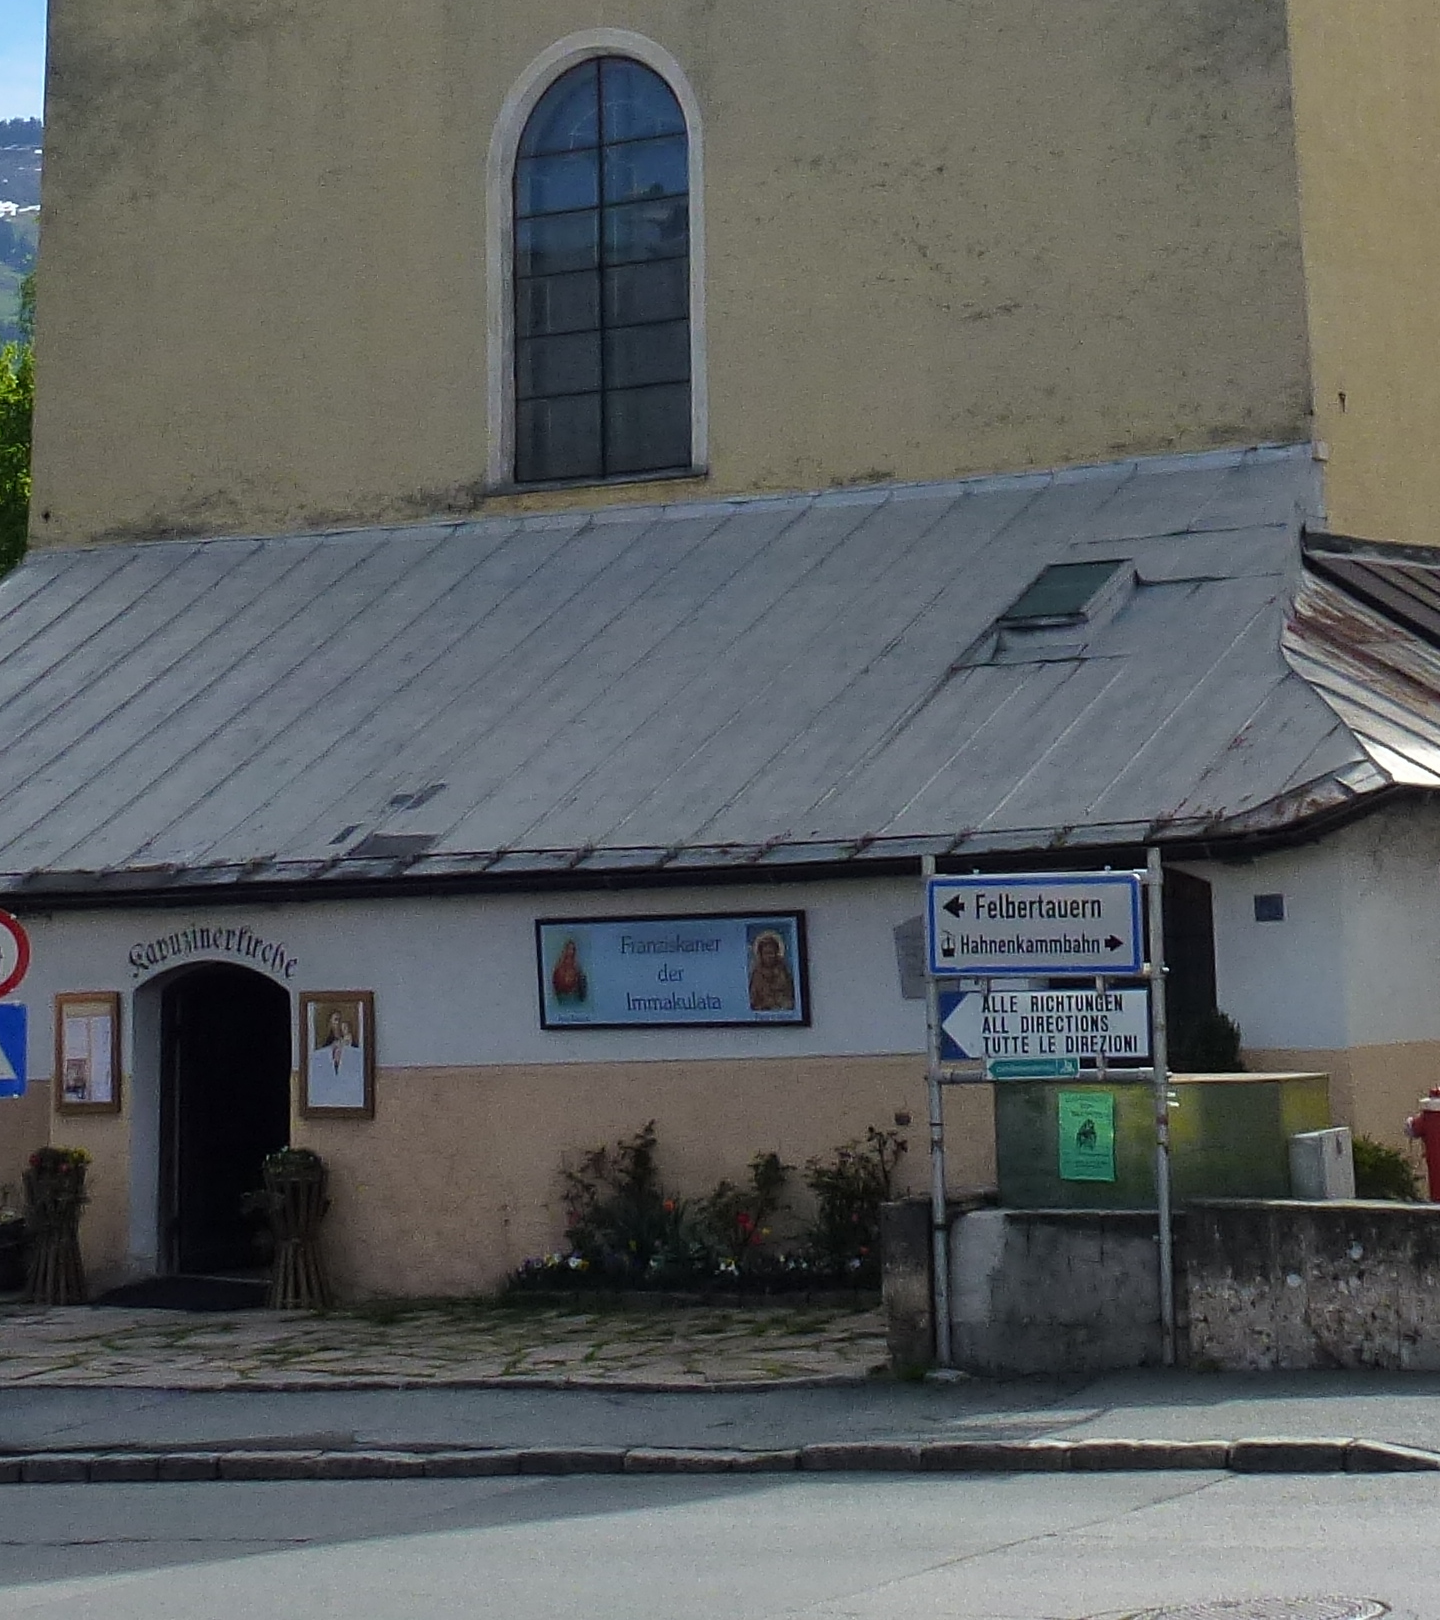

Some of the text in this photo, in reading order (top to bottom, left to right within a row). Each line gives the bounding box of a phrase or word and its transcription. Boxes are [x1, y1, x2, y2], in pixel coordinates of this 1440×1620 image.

[975, 893, 1102, 919] Felbertauern
[128, 923, 298, 979] Kapuzinerkirche
[620, 934, 722, 954] Franziskaner
[960, 932, 1100, 955] Hahnenkammbahn
[657, 963, 685, 982] der
[626, 991, 722, 1012] Immakulata
[981, 993, 1124, 1013] ALLE RICHTUNGEN
[981, 1015, 1109, 1034] ALL DIRECTIONS
[981, 1035, 1139, 1054] TUTTE LE DIREZIONI
